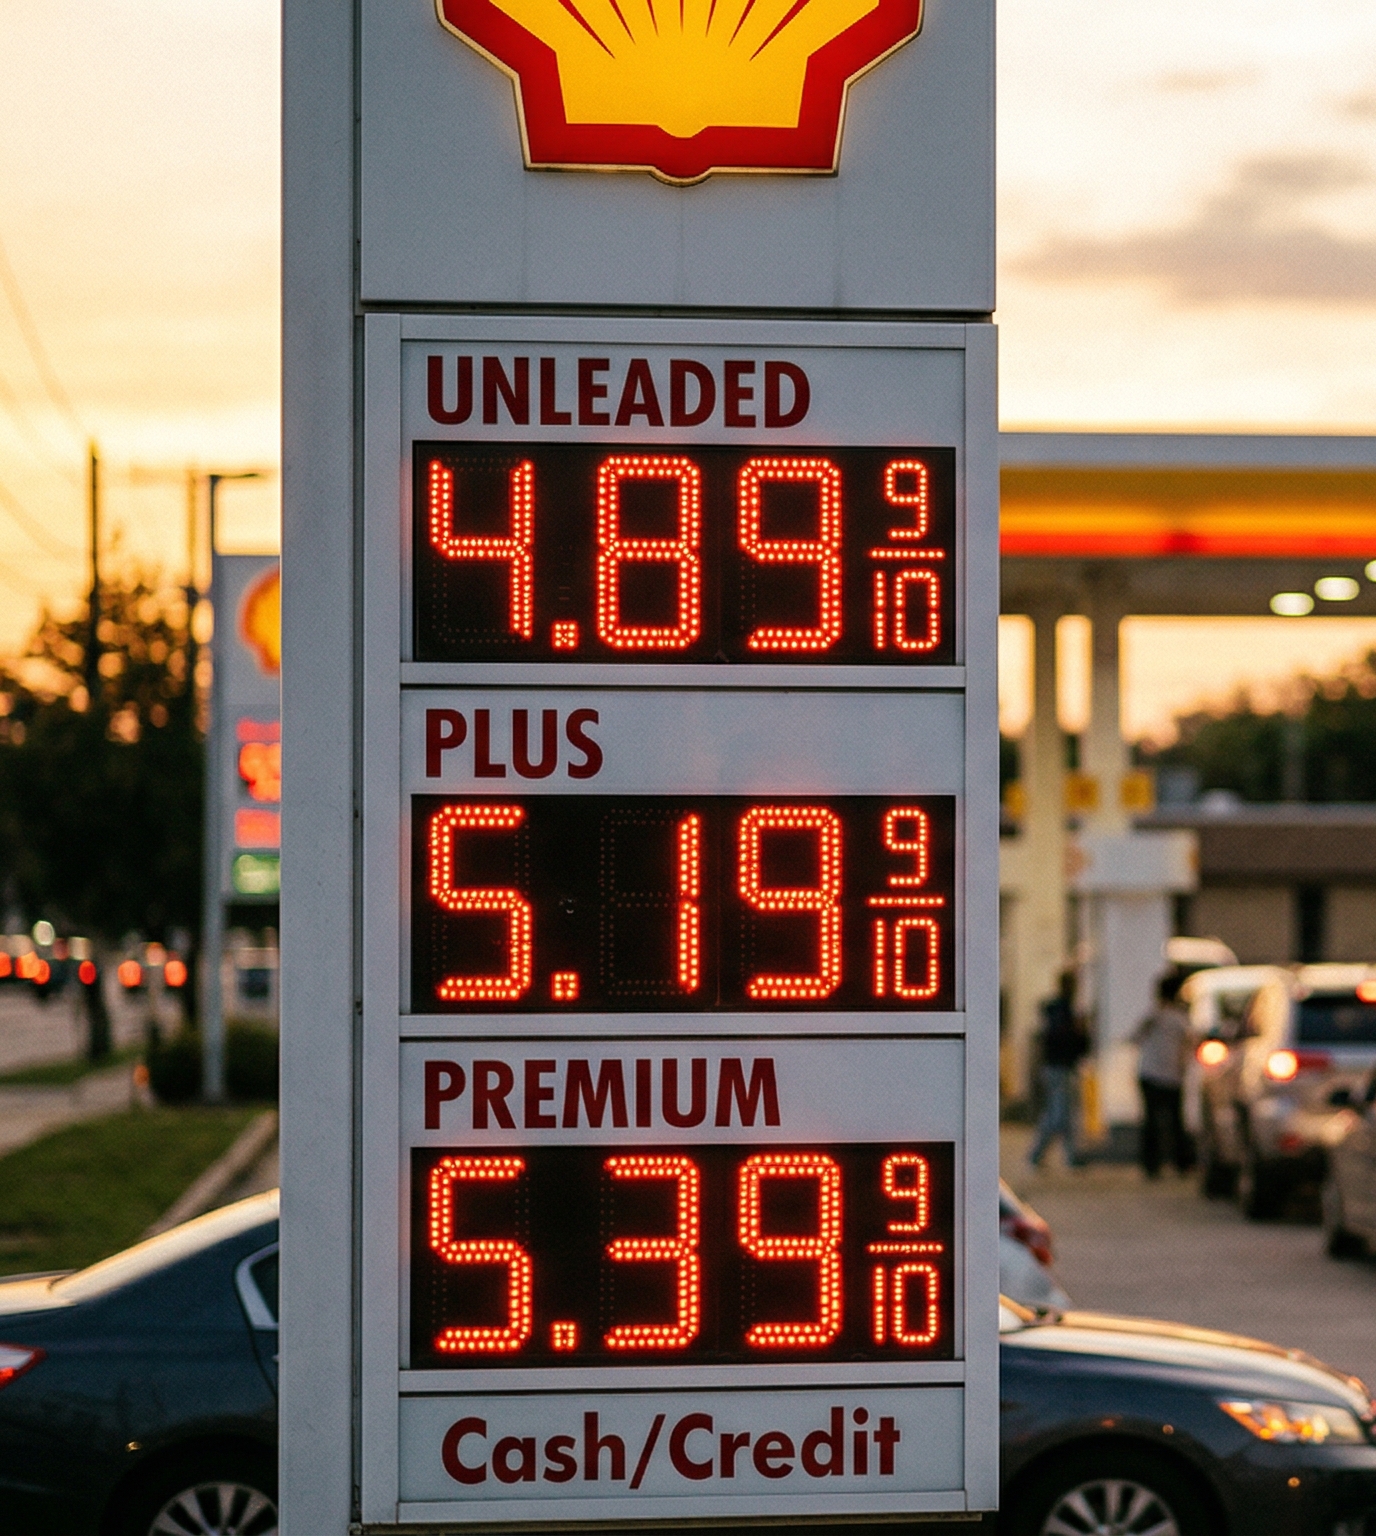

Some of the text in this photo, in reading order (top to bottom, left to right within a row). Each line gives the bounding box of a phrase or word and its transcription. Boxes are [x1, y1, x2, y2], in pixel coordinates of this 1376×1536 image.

[426, 355, 811, 428] UNLEADED
[430, 456, 842, 650] 4.89
[425, 708, 603, 779] PLUS
[429, 806, 842, 1000] 5.19
[424, 1057, 781, 1130] PREMIUM
[430, 1154, 842, 1352] 5.39
[441, 1406, 901, 1489] Cash/Credit
